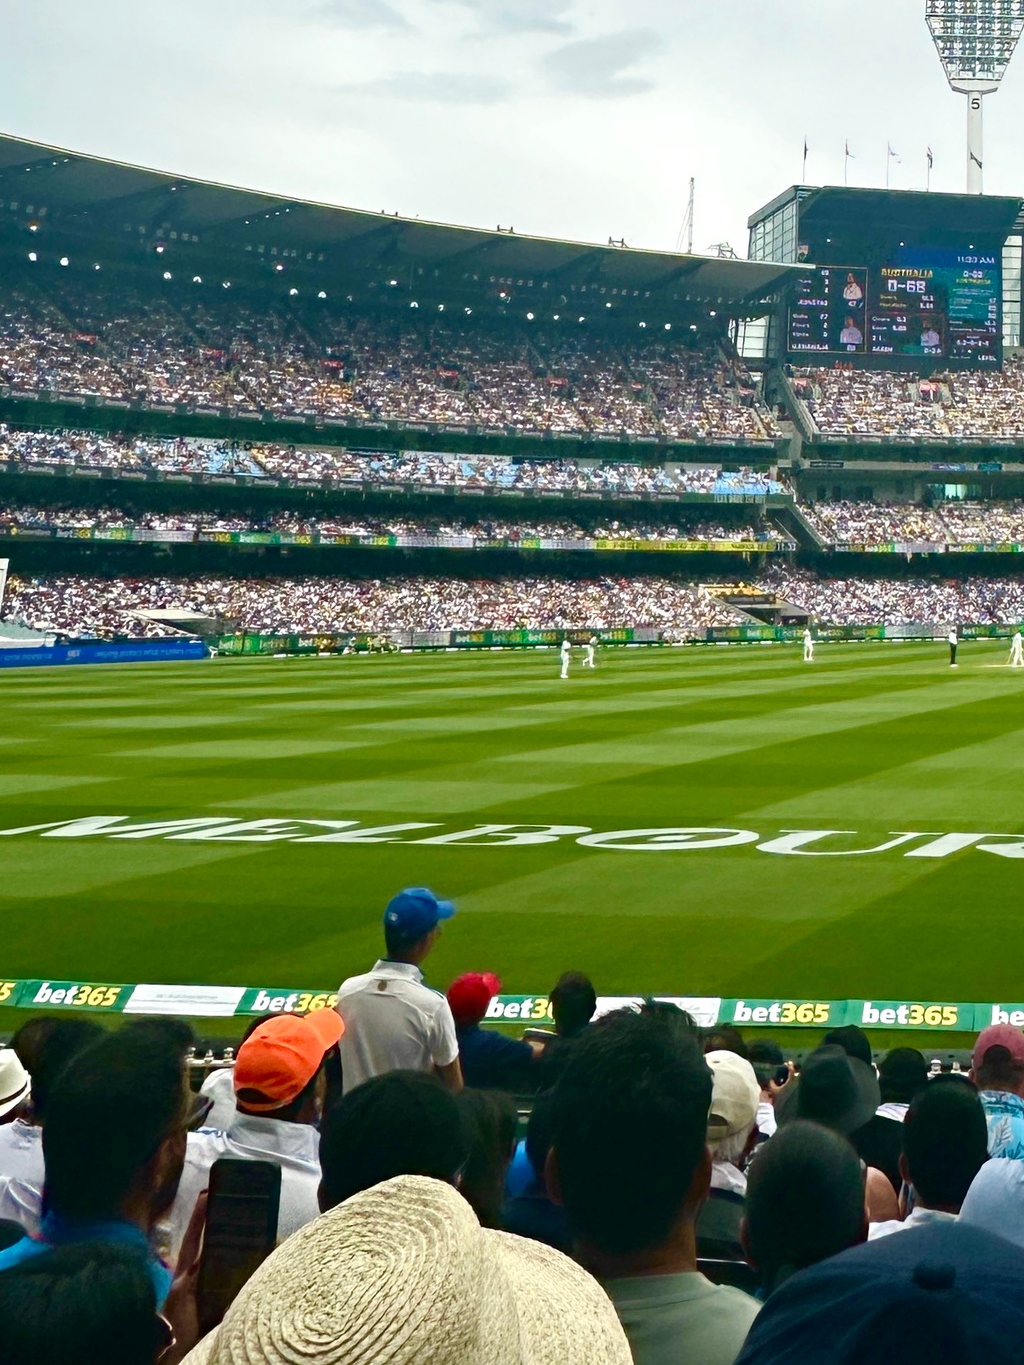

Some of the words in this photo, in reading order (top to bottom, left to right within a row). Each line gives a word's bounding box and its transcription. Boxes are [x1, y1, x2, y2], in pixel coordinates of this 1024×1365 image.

[971, 98, 980, 109] 5
[33, 982, 121, 1007] bet365
[733, 1001, 830, 1023] bet365
[861, 1002, 958, 1026] bet365
